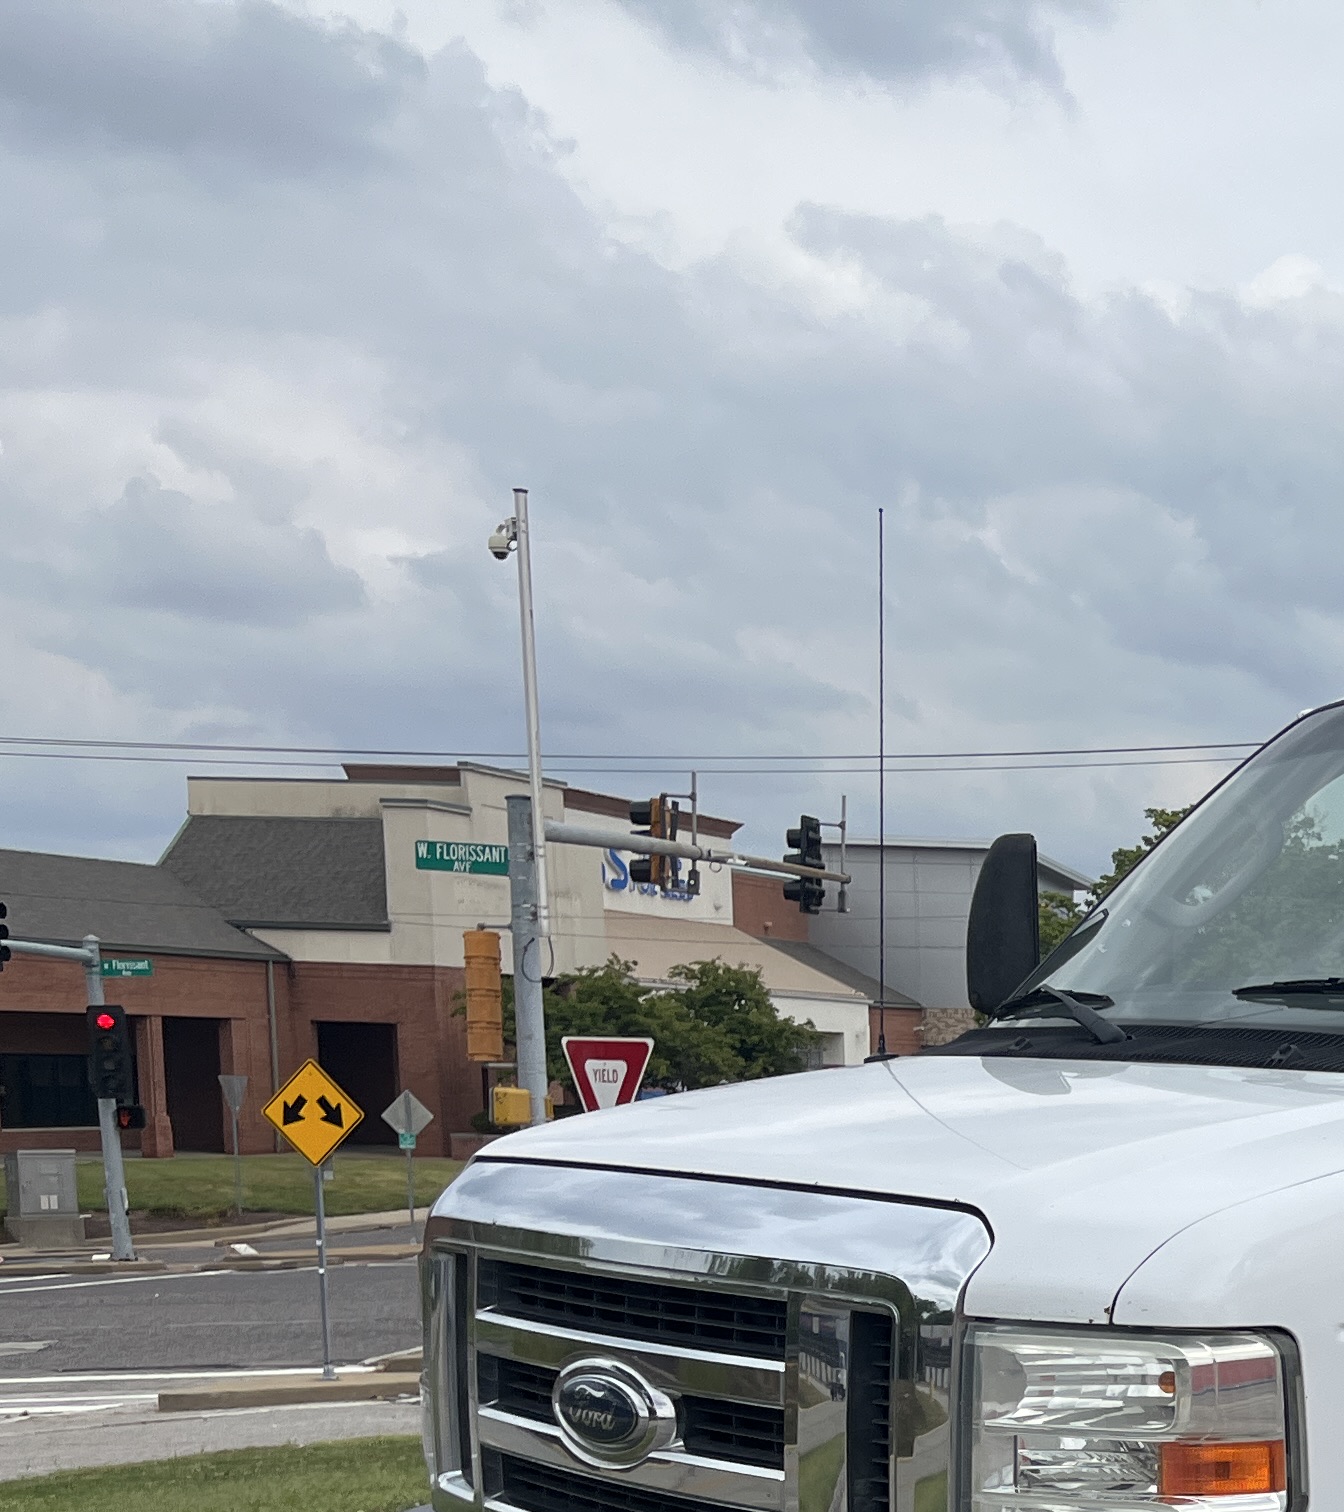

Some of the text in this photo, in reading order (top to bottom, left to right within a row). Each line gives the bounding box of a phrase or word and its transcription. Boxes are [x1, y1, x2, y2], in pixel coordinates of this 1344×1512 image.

[416, 842, 506, 863] W. FLORISSANT
[592, 1068, 619, 1084] YIELD
